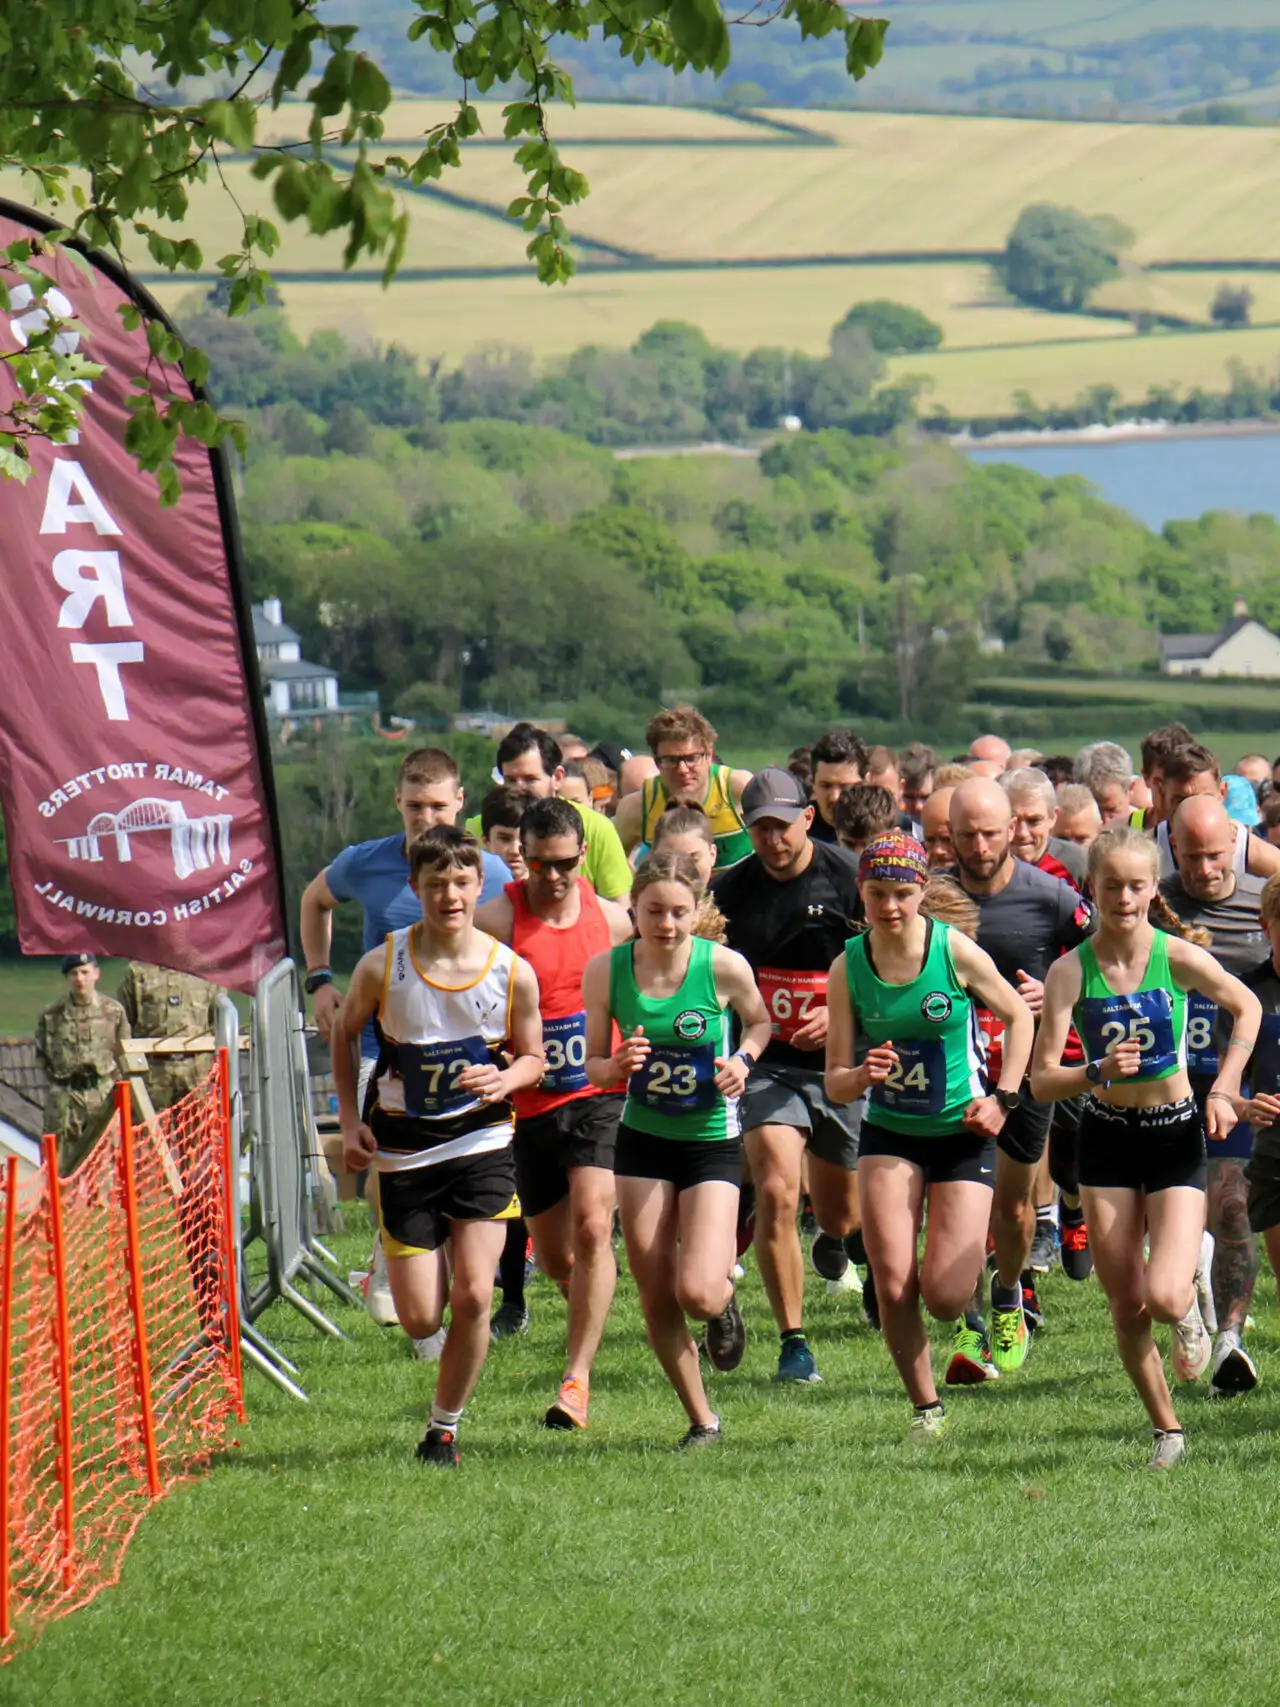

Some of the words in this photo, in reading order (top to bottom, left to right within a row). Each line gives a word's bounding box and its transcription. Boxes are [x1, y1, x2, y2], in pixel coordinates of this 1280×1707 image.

[870, 856, 905, 868] RUN
[772, 987, 815, 1019] 67
[543, 1034, 587, 1070] 30
[1101, 1016, 1156, 1055] 25
[420, 1058, 473, 1093] 72
[647, 1060, 697, 1096] 23
[884, 1060, 931, 1092] 24
[1140, 1110, 1193, 1128] NIKE
